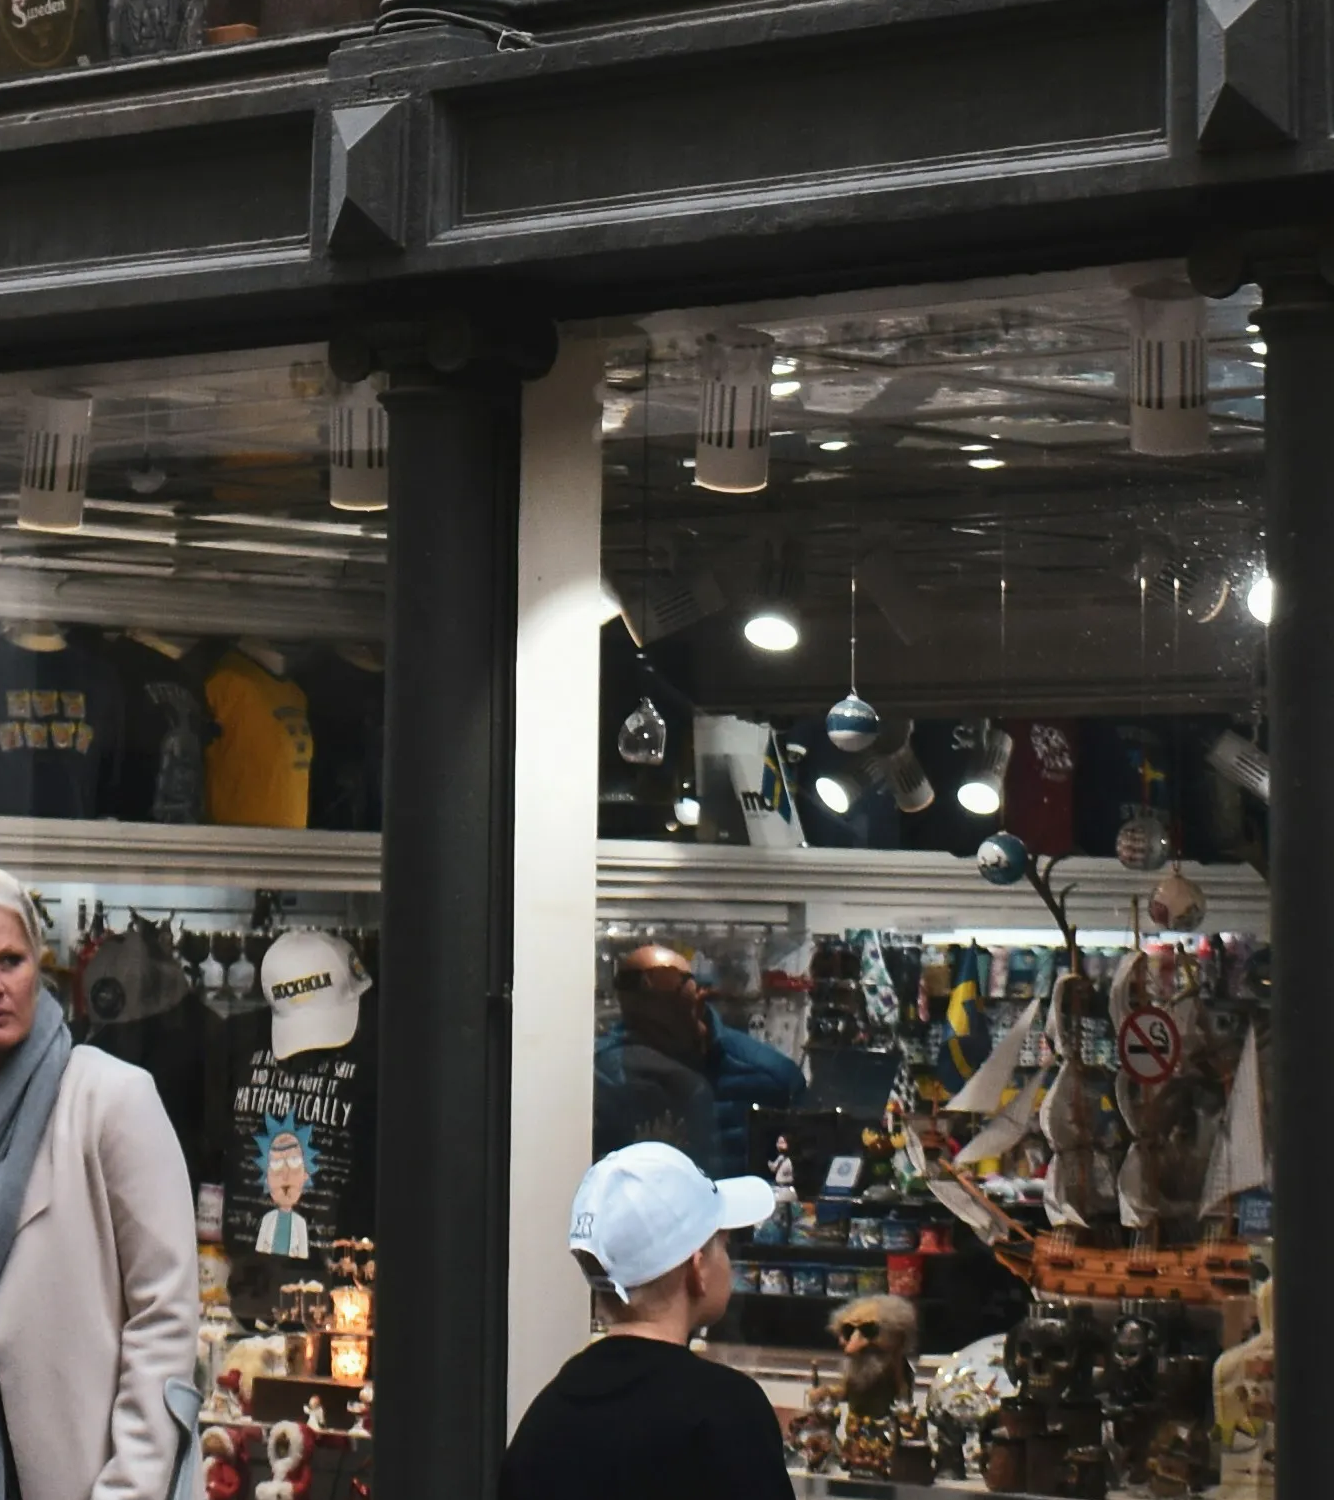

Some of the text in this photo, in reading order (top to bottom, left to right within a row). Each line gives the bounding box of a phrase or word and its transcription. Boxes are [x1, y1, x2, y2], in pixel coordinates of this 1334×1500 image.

[297, 1072, 324, 1095] PROVE
[327, 1078, 339, 1096] IT
[234, 1085, 353, 1127] MATHEMATICALLY
